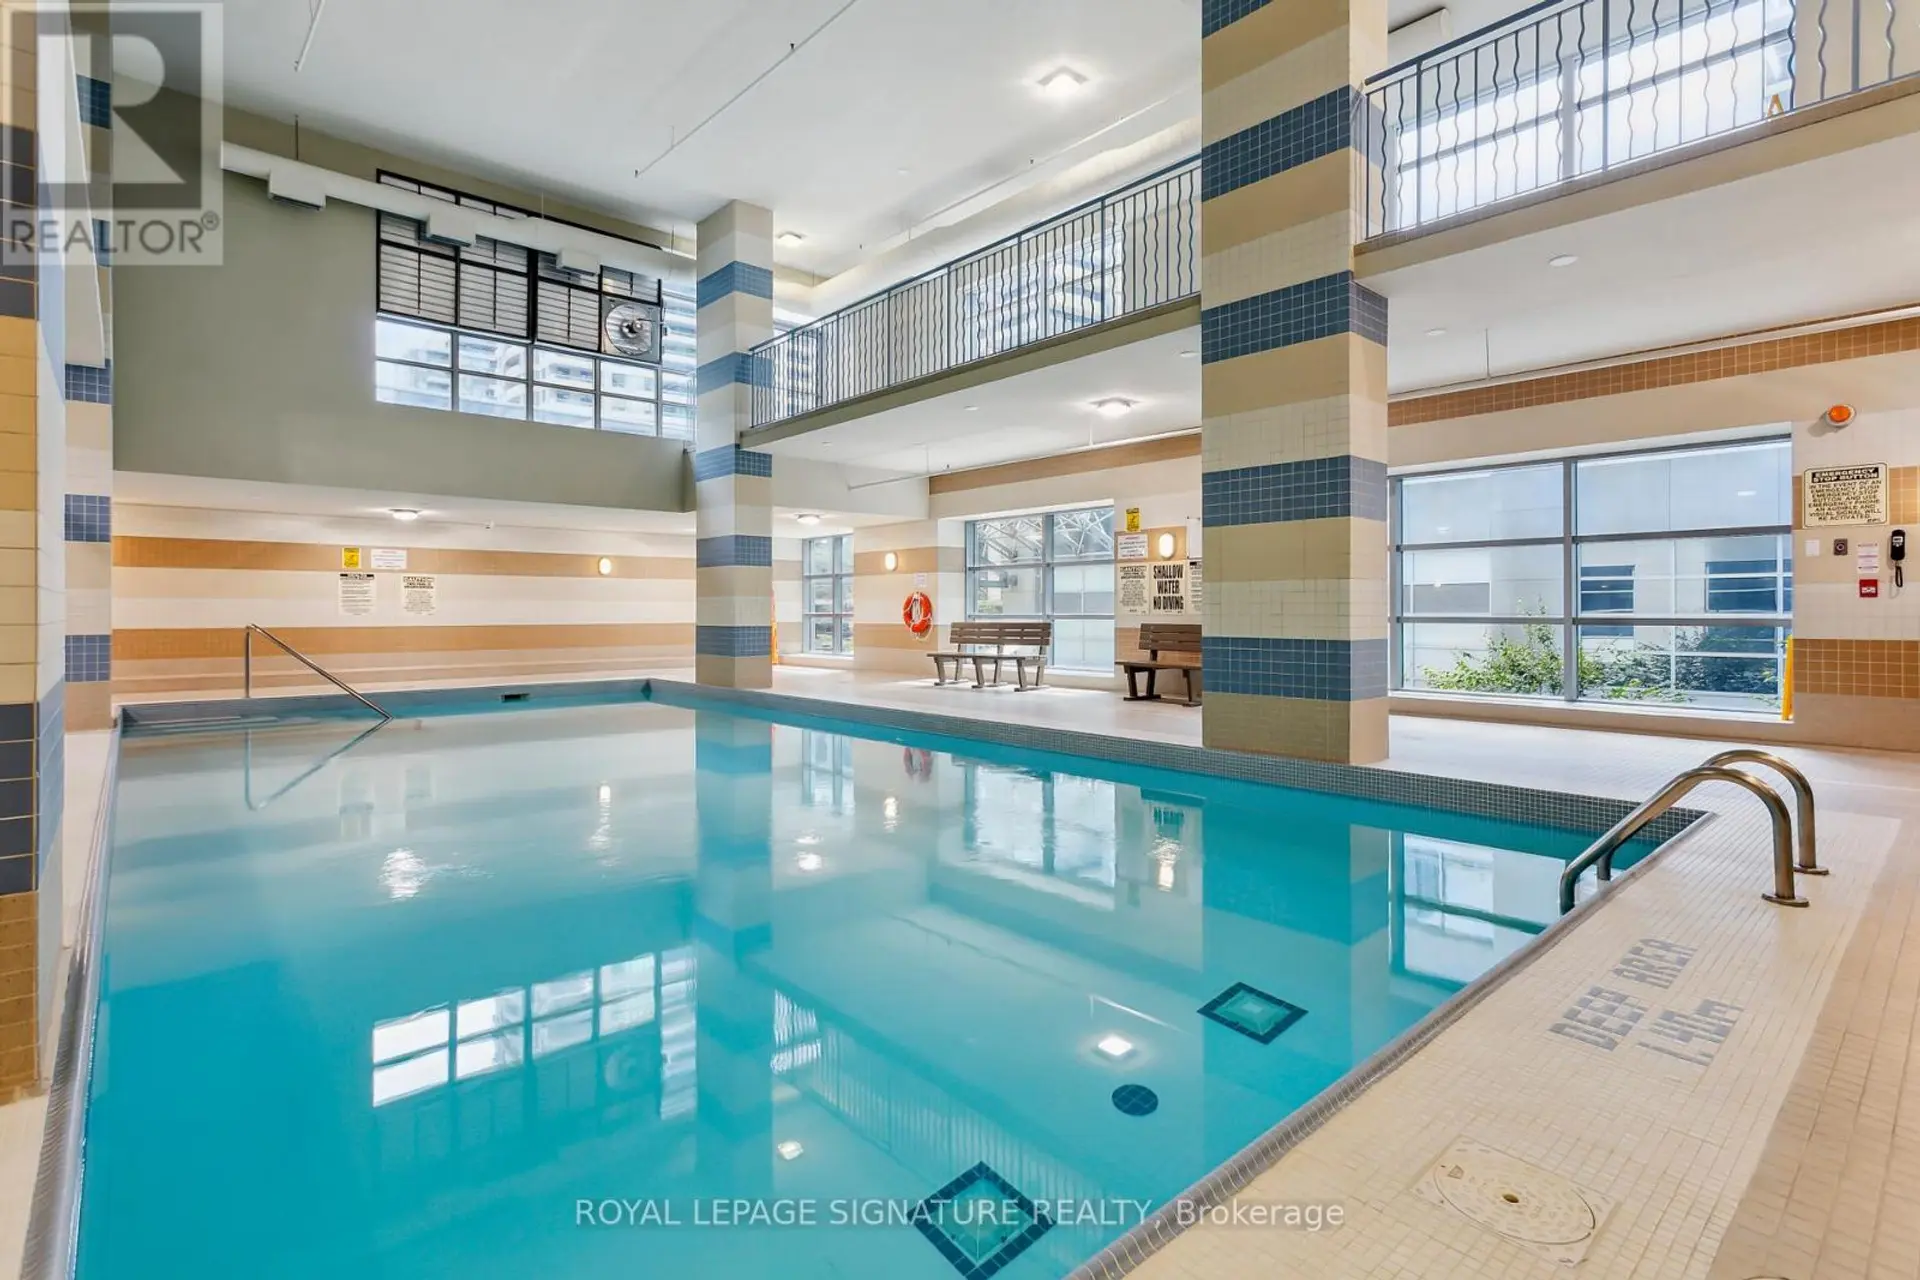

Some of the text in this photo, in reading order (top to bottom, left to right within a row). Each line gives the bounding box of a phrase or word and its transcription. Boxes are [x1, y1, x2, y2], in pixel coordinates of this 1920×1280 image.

[1815, 468, 1875, 476] EMERGENCY
[1154, 564, 1183, 579] SHALLOW
[1157, 580, 1180, 594] WATER
[1154, 596, 1184, 609] NO DIVING
